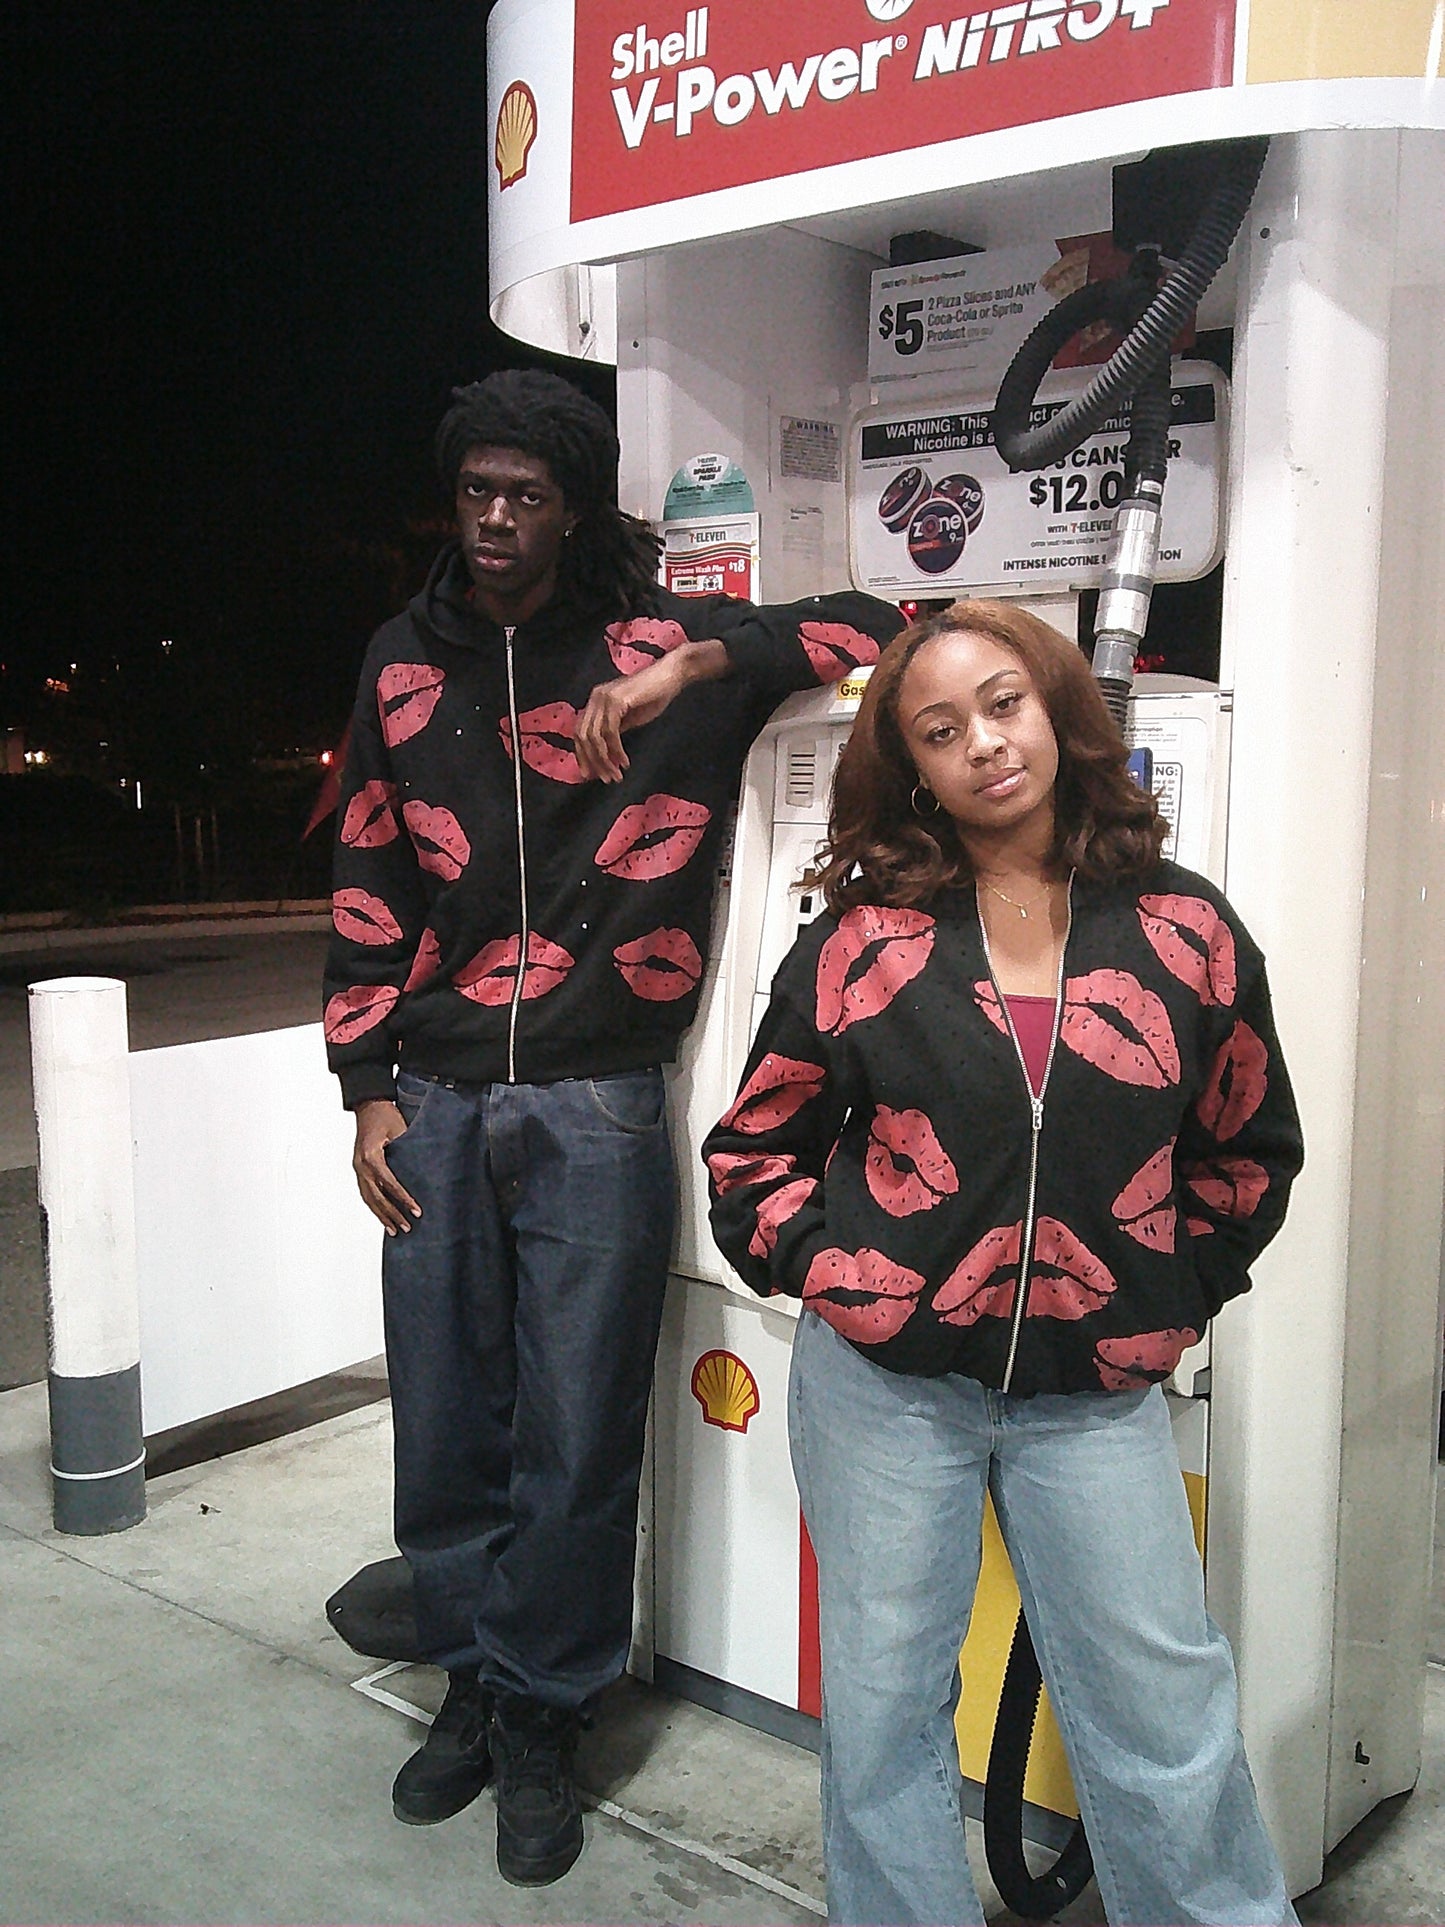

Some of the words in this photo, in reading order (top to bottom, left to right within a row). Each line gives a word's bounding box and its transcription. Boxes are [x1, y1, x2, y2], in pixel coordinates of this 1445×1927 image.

[610, 6, 709, 80] Shell
[928, 298, 936, 311] 2
[936, 294, 962, 309] Pizza
[963, 290, 994, 306] Slices
[994, 286, 1014, 301] and
[1015, 281, 1037, 297] ANY
[927, 308, 978, 327] Coca-Cola
[979, 306, 991, 319] or
[992, 302, 1024, 319] Sprite
[878, 299, 924, 356] $5
[926, 325, 967, 343] Product
[886, 418, 956, 440] WARNING:
[959, 415, 989, 431] This
[914, 434, 969, 451] Nicotine
[972, 432, 984, 445] is
[1029, 471, 1122, 514] $12.0
[689, 531, 727, 544] 7-ELEVEN
[912, 514, 961, 538] zone
[1047, 524, 1068, 534] WITH
[728, 558, 746, 573] $18
[1003, 558, 1047, 571] INTENSE
[1049, 555, 1098, 568] NICOTINE
